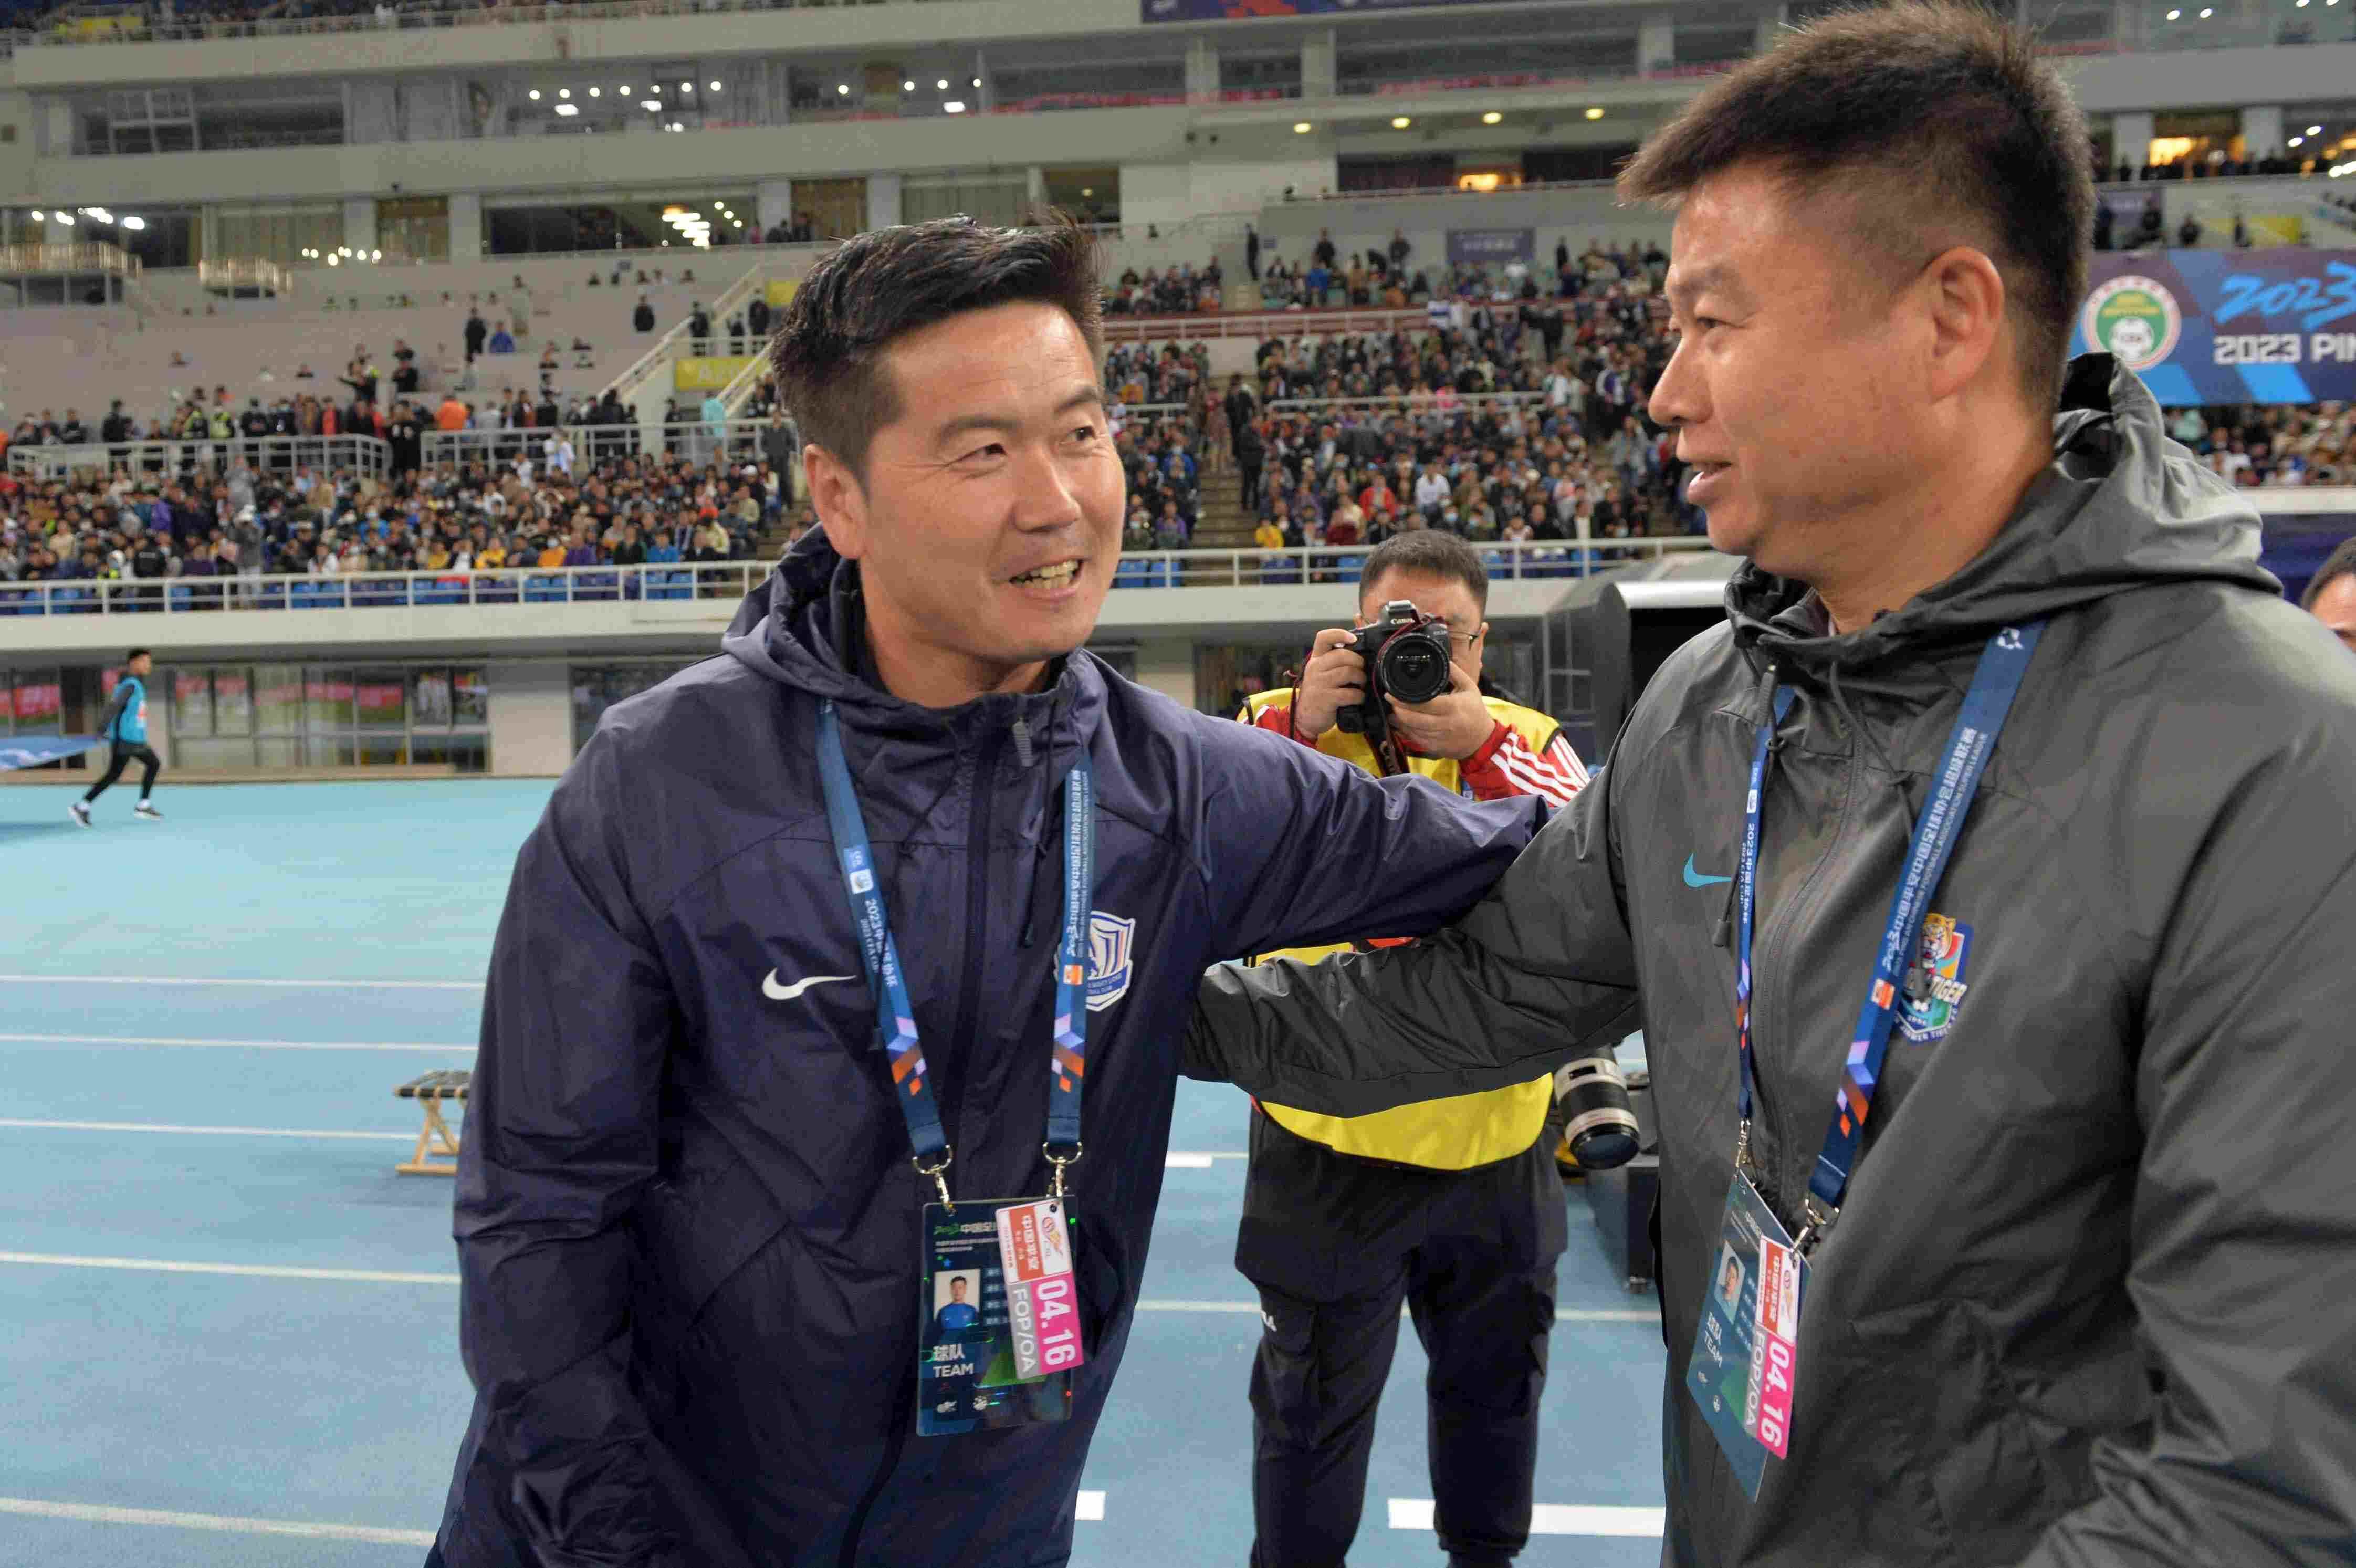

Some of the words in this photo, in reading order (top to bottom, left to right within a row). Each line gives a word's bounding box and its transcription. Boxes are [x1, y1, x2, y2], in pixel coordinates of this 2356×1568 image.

[2214, 261, 2356, 332] 2023
[2214, 333, 2301, 365] 2023
[1014, 1288, 1036, 1372] FOP/OA
[1036, 1279, 1076, 1366] 04.16
[1705, 1330, 1722, 1368] TEAM
[933, 1363, 974, 1378] TEAM
[1746, 1331, 1766, 1425] FOP/OA
[1761, 1341, 1790, 1447] 04.16
